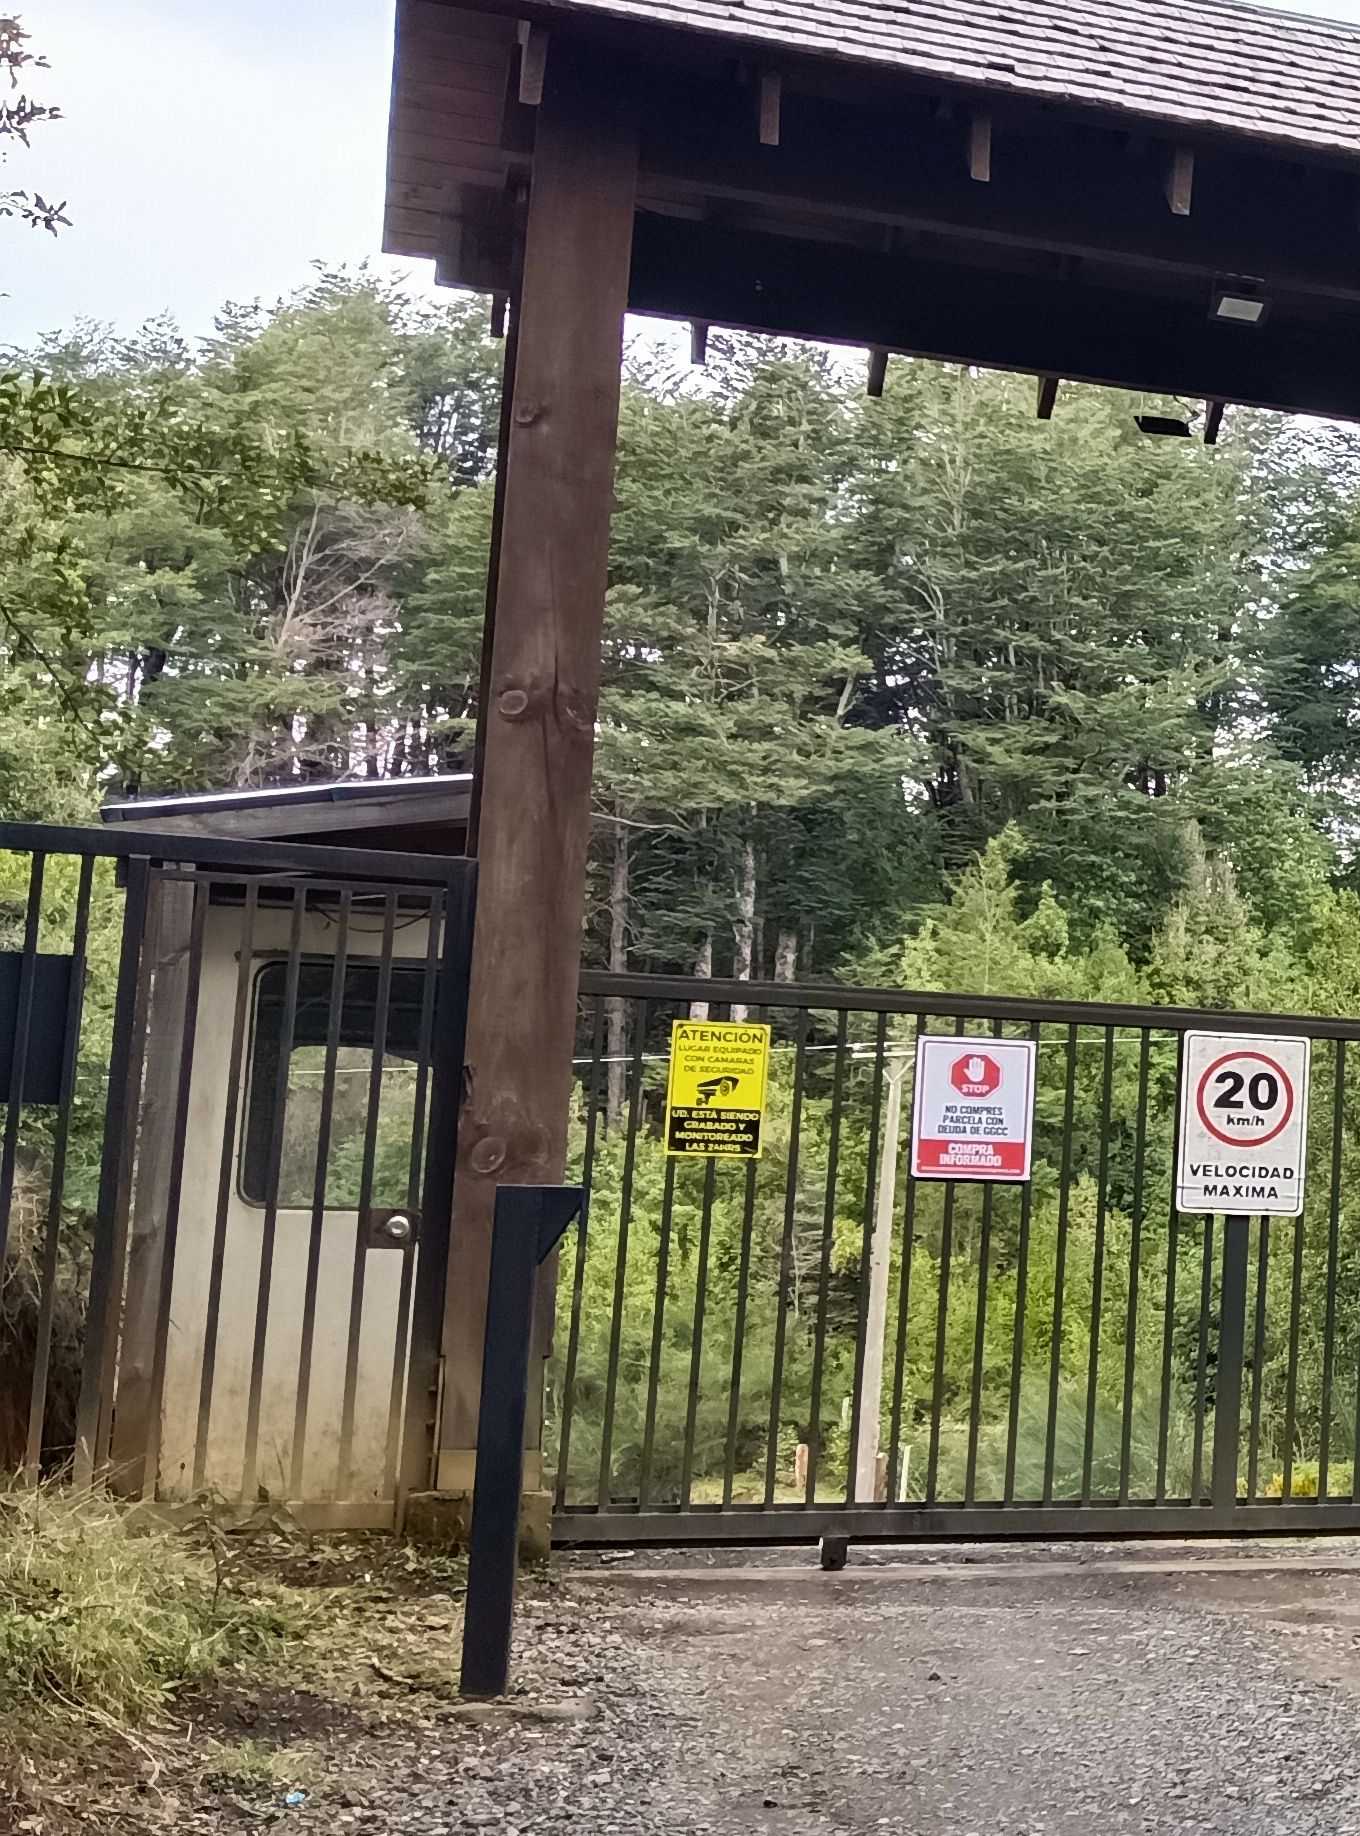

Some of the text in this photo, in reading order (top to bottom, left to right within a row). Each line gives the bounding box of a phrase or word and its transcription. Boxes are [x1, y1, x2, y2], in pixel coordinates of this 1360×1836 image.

[678, 1029, 763, 1044] ATENCIÓN
[678, 1044, 762, 1055] LUGAR EQUIPADO
[684, 1065, 754, 1075] DE SEGURIDAD
[962, 1084, 990, 1094] STOP
[1213, 1070, 1279, 1111] 20
[945, 1105, 1003, 1116] NO COMPRES
[720, 1112, 759, 1121] SIENDO
[943, 1114, 1004, 1126] PARCELA CON
[1226, 1115, 1265, 1127] km/h
[683, 1121, 746, 1131] GRABADO Y
[938, 1125, 1008, 1136] DEUDA DE GGCC
[675, 1131, 754, 1142] MONITOREADO
[685, 1143, 706, 1151] LAS
[948, 1143, 994, 1155] COMPRA
[939, 1153, 1002, 1166] INFORMADO
[1189, 1164, 1294, 1180] VELOCIDAD
[1203, 1185, 1279, 1199] MAXIMA
